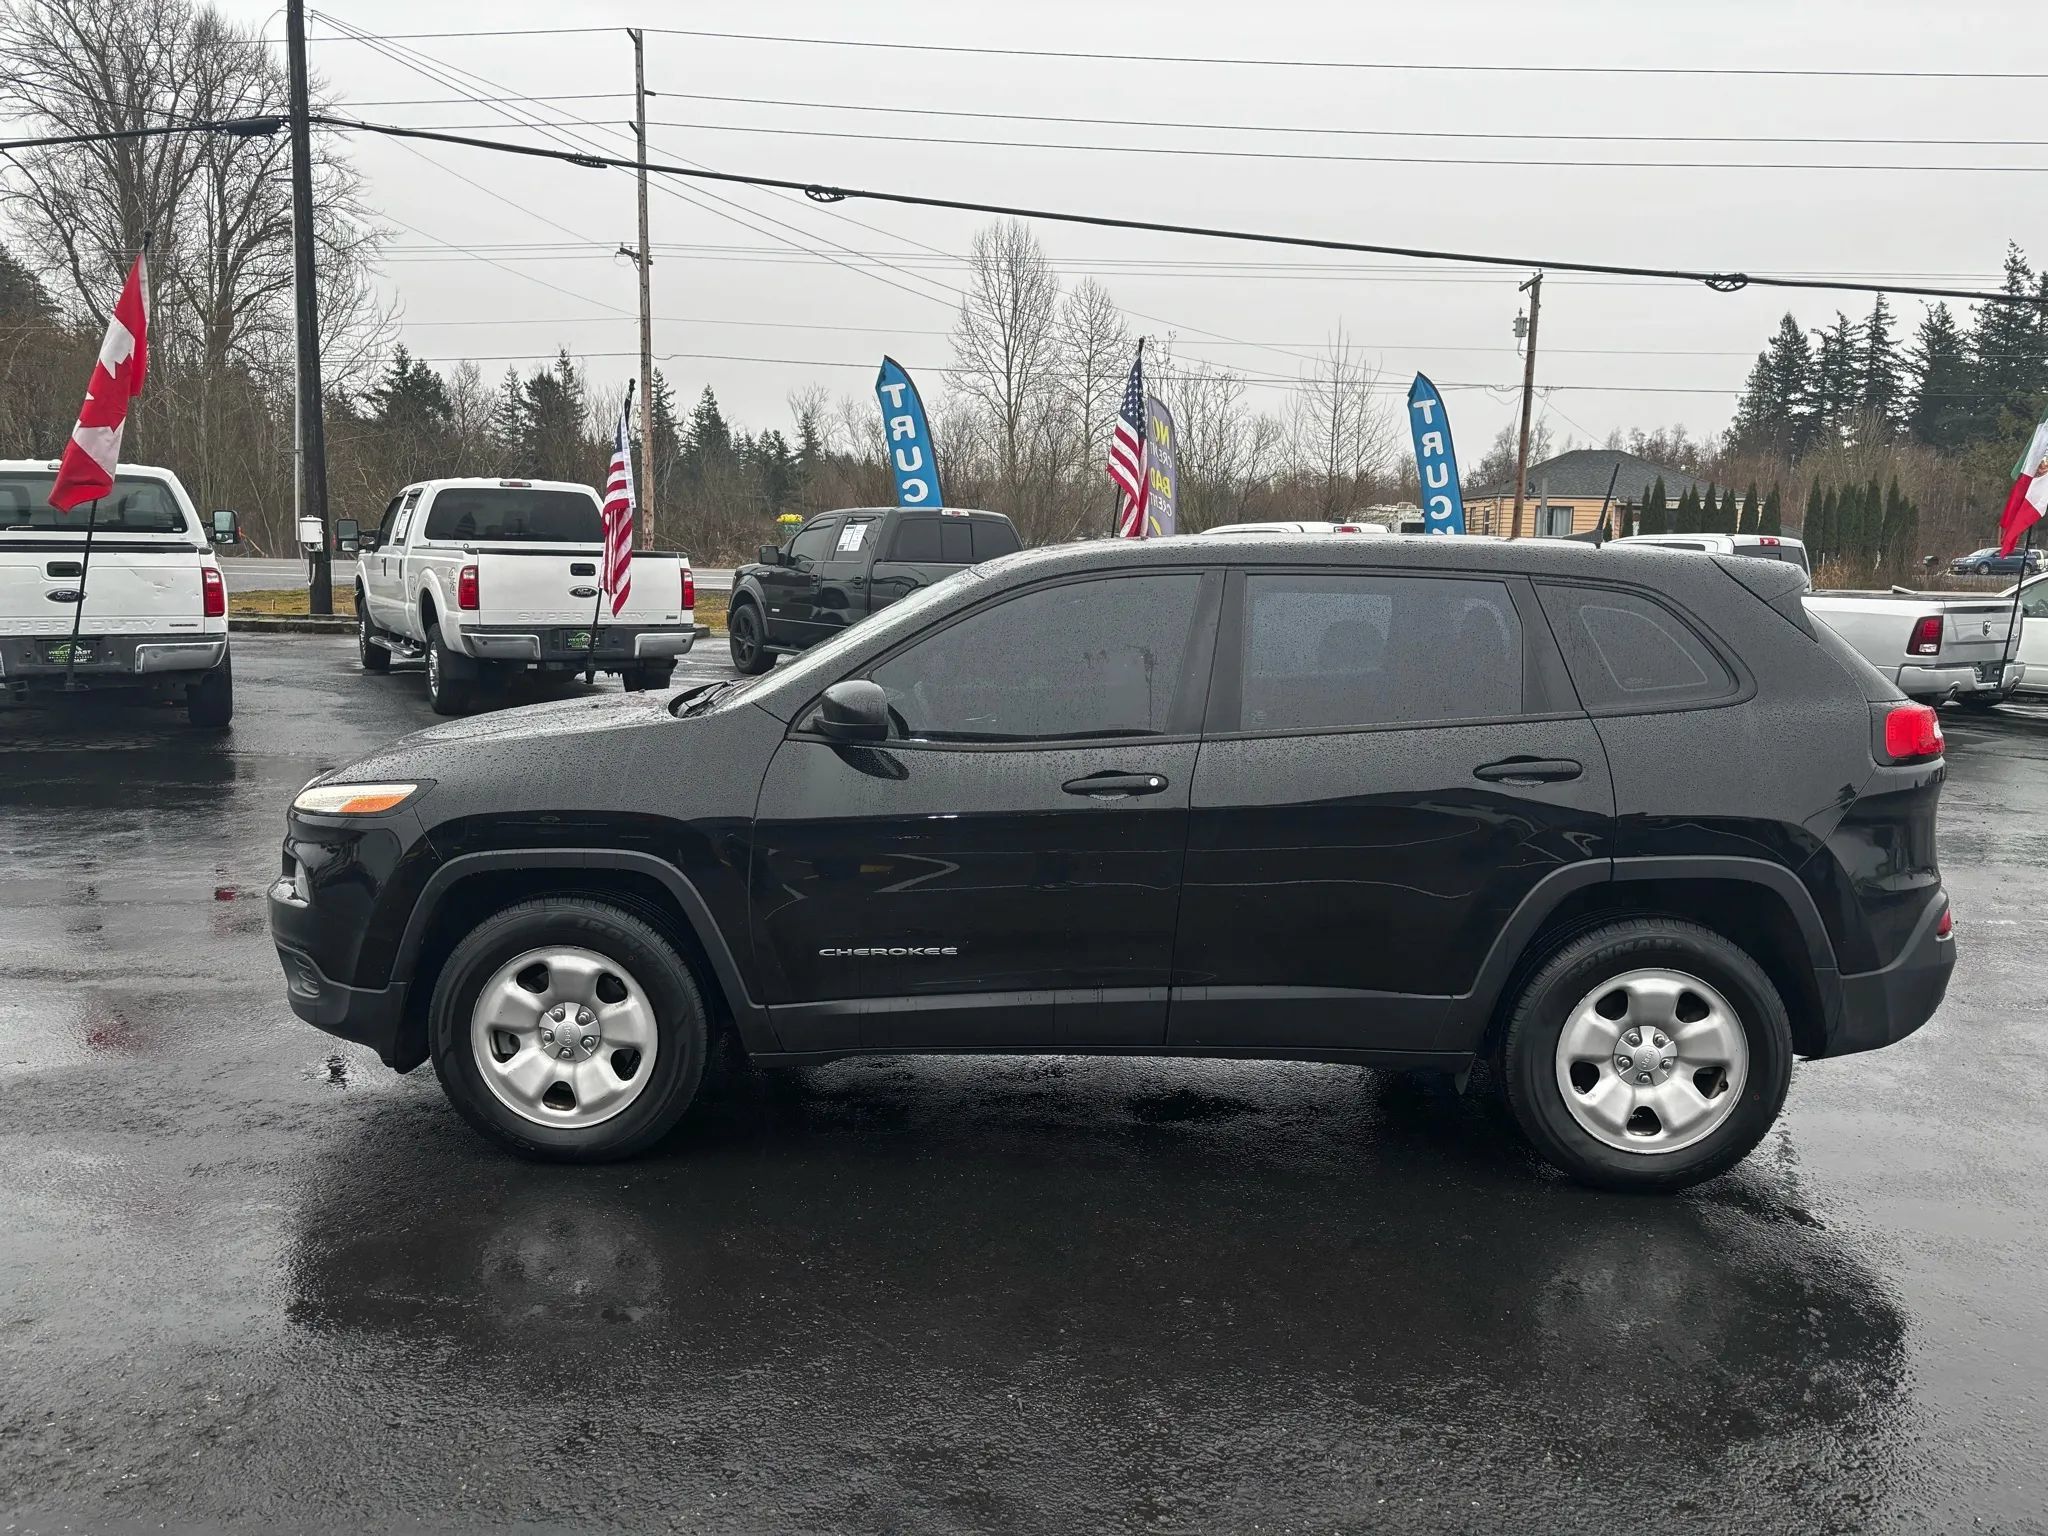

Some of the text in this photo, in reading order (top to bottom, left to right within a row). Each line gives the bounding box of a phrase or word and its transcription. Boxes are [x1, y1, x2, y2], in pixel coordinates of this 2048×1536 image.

[517, 611, 648, 623] SUPER DUTY
[88, 618, 160, 632] DUTY
[818, 947, 958, 957] CHEROKEE
